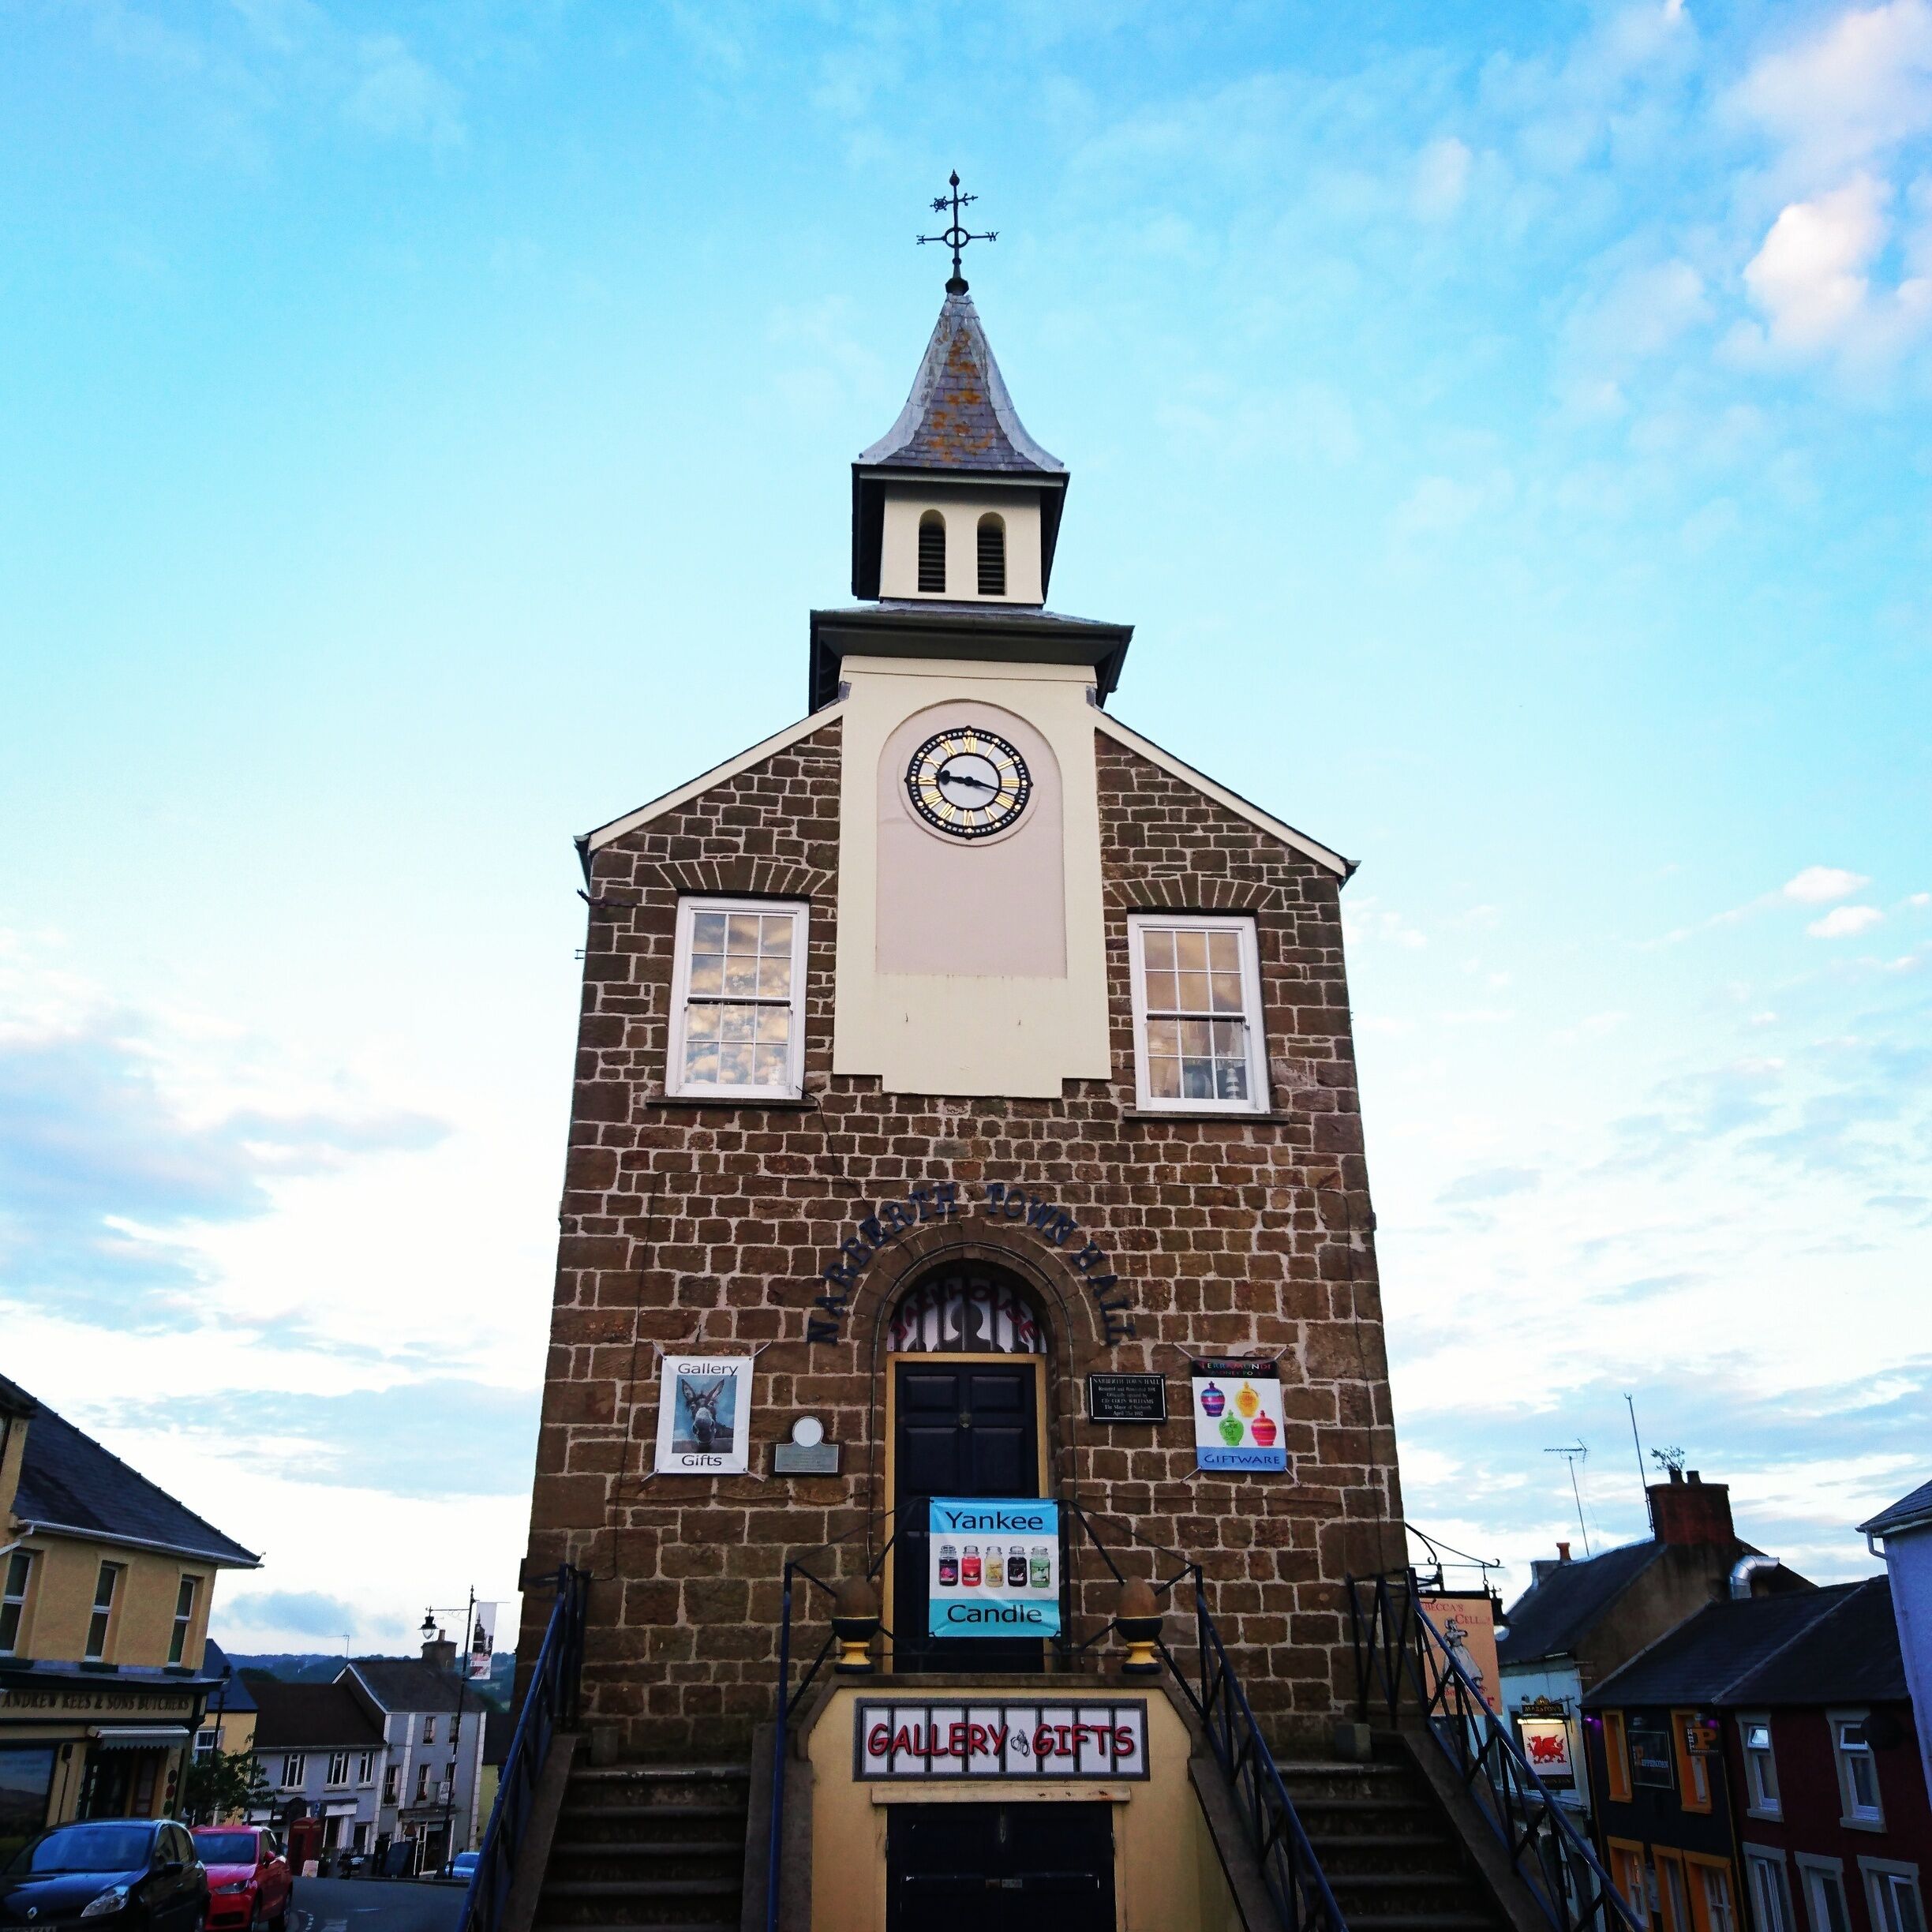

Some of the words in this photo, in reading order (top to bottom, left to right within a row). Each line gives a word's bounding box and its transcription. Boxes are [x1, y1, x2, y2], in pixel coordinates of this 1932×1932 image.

[940, 739, 957, 758] XI
[962, 737, 978, 754] XII
[923, 754, 942, 769] X
[996, 758, 1014, 770] II
[1001, 777, 1020, 788] III
[807, 1183, 960, 1344] NARBERTH
[985, 1183, 1079, 1246] TOWN
[1071, 1240, 1136, 1347] HALL
[678, 1363, 739, 1376] Gallery
[682, 1455, 722, 1466] Gifts
[1204, 1454, 1280, 1465] GIFTWARE
[945, 1511, 1044, 1530] Yankee
[947, 1604, 1043, 1623] Candle
[2, 1691, 57, 1709] ANDREW
[62, 1694, 92, 1709] REES
[94, 1695, 103, 1709] &
[107, 1695, 134, 1710] SONS
[137, 1696, 189, 1711] BUTCHERS
[867, 1723, 1009, 1757] GALLERY
[1032, 1724, 1135, 1757] GIFTS
